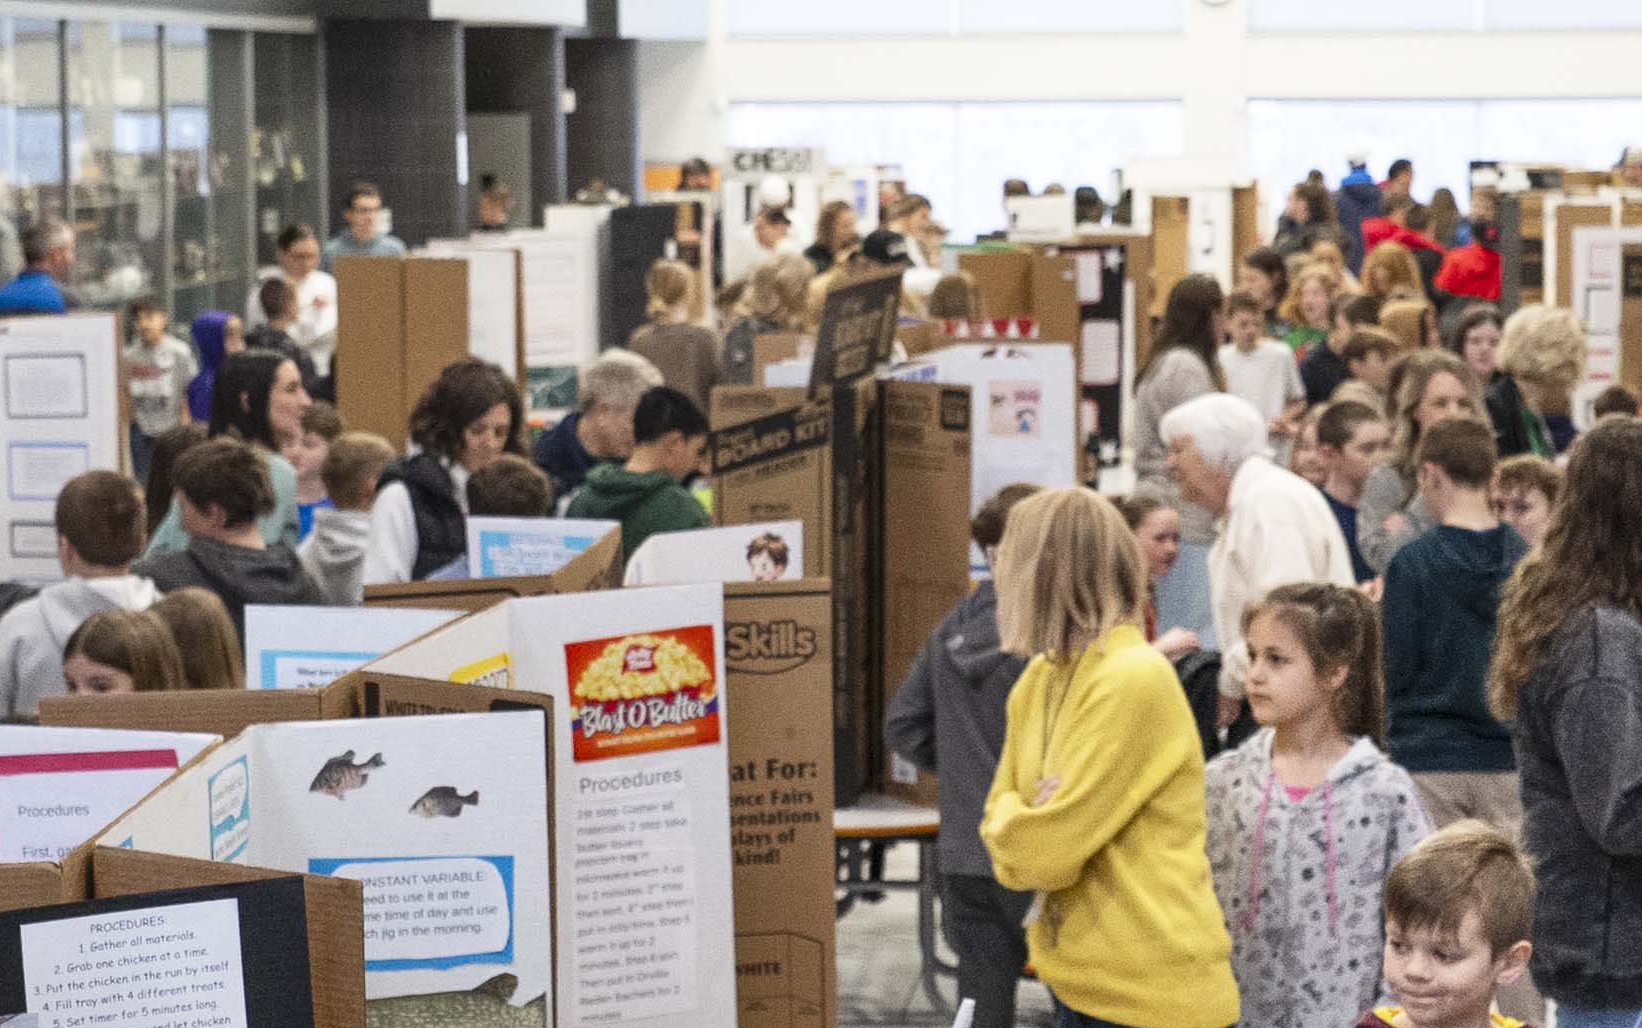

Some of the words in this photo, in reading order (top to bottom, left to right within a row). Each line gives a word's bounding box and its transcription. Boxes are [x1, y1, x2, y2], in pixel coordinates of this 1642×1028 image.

[766, 758, 818, 781] For:
[579, 768, 683, 794] Procedures
[18, 805, 90, 818] Procedures
[363, 876, 417, 888] ONSTANT
[89, 940, 127, 952] Gather
[130, 936, 142, 946] all
[66, 961, 92, 973] Grab
[95, 959, 113, 969] one
[117, 954, 157, 966] chicken
[159, 951, 170, 960] at
[174, 951, 180, 959] a
